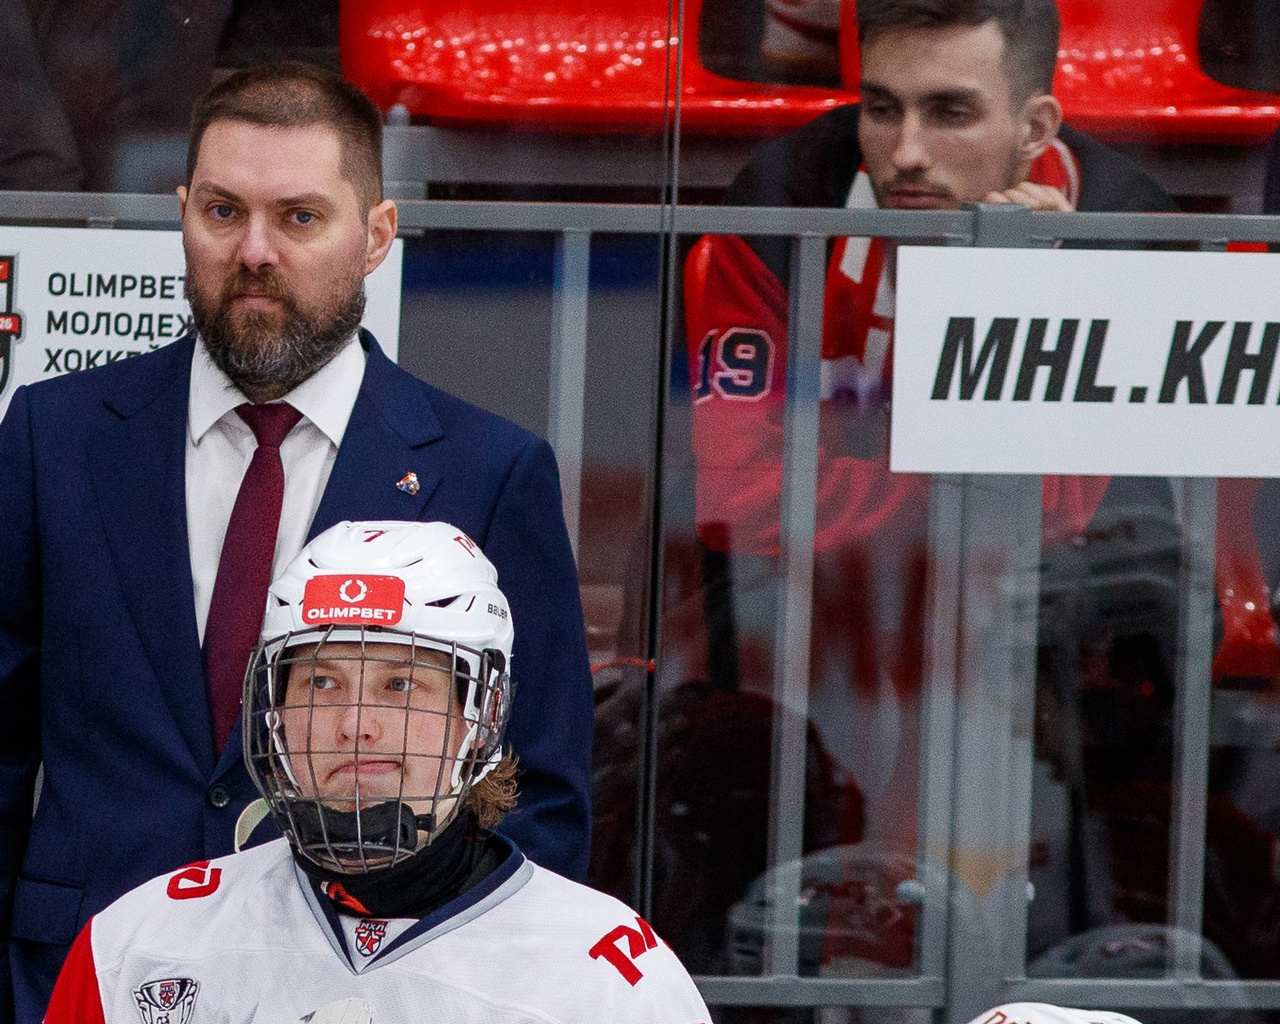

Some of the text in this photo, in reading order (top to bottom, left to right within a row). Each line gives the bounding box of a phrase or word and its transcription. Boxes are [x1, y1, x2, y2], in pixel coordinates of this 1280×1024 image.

[43, 344, 160, 373] ХОКК
[693, 327, 776, 405] 19
[929, 316, 1280, 405] MHL.KH
[363, 530, 388, 543] 7
[307, 607, 397, 621] OLIMPBET
